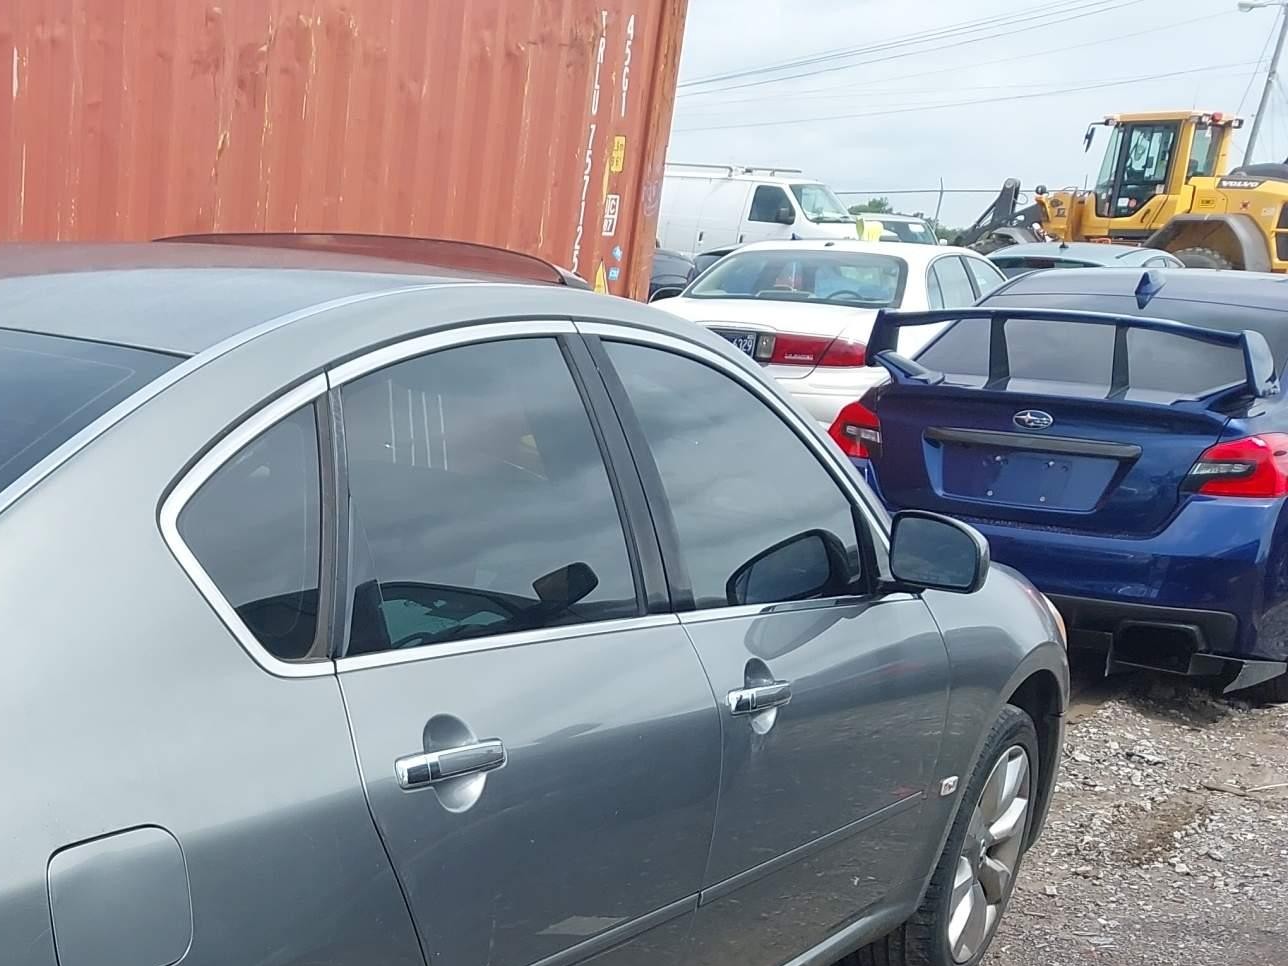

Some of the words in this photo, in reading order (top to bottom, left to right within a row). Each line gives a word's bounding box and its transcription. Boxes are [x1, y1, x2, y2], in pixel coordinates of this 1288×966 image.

[591, 10, 608, 116] TRLU
[620, 14, 635, 118] 45G1
[1221, 180, 1259, 188] VOLVO
